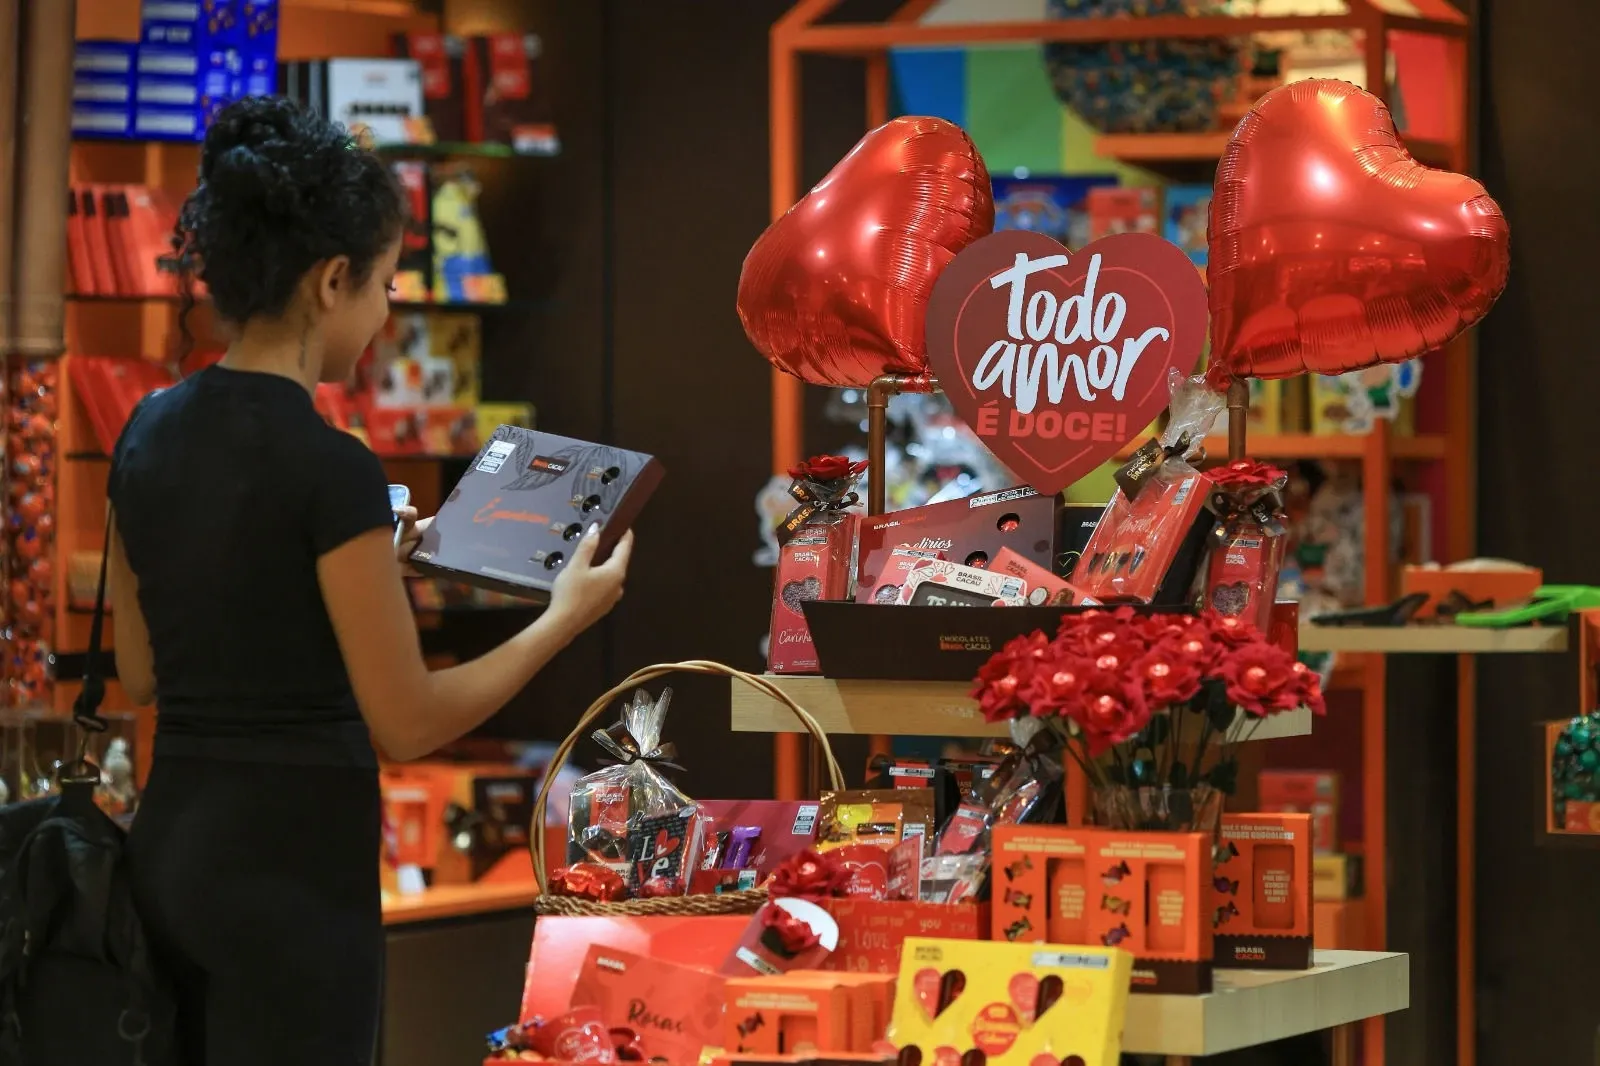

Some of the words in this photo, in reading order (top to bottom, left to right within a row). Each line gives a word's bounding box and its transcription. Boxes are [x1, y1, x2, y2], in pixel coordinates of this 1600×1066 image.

[972, 327, 1169, 414] amor
[977, 400, 1000, 436] É
[1009, 409, 1127, 442] DOCE!
[956, 577, 981, 587] CACAU
[957, 571, 983, 582] BRASIL
